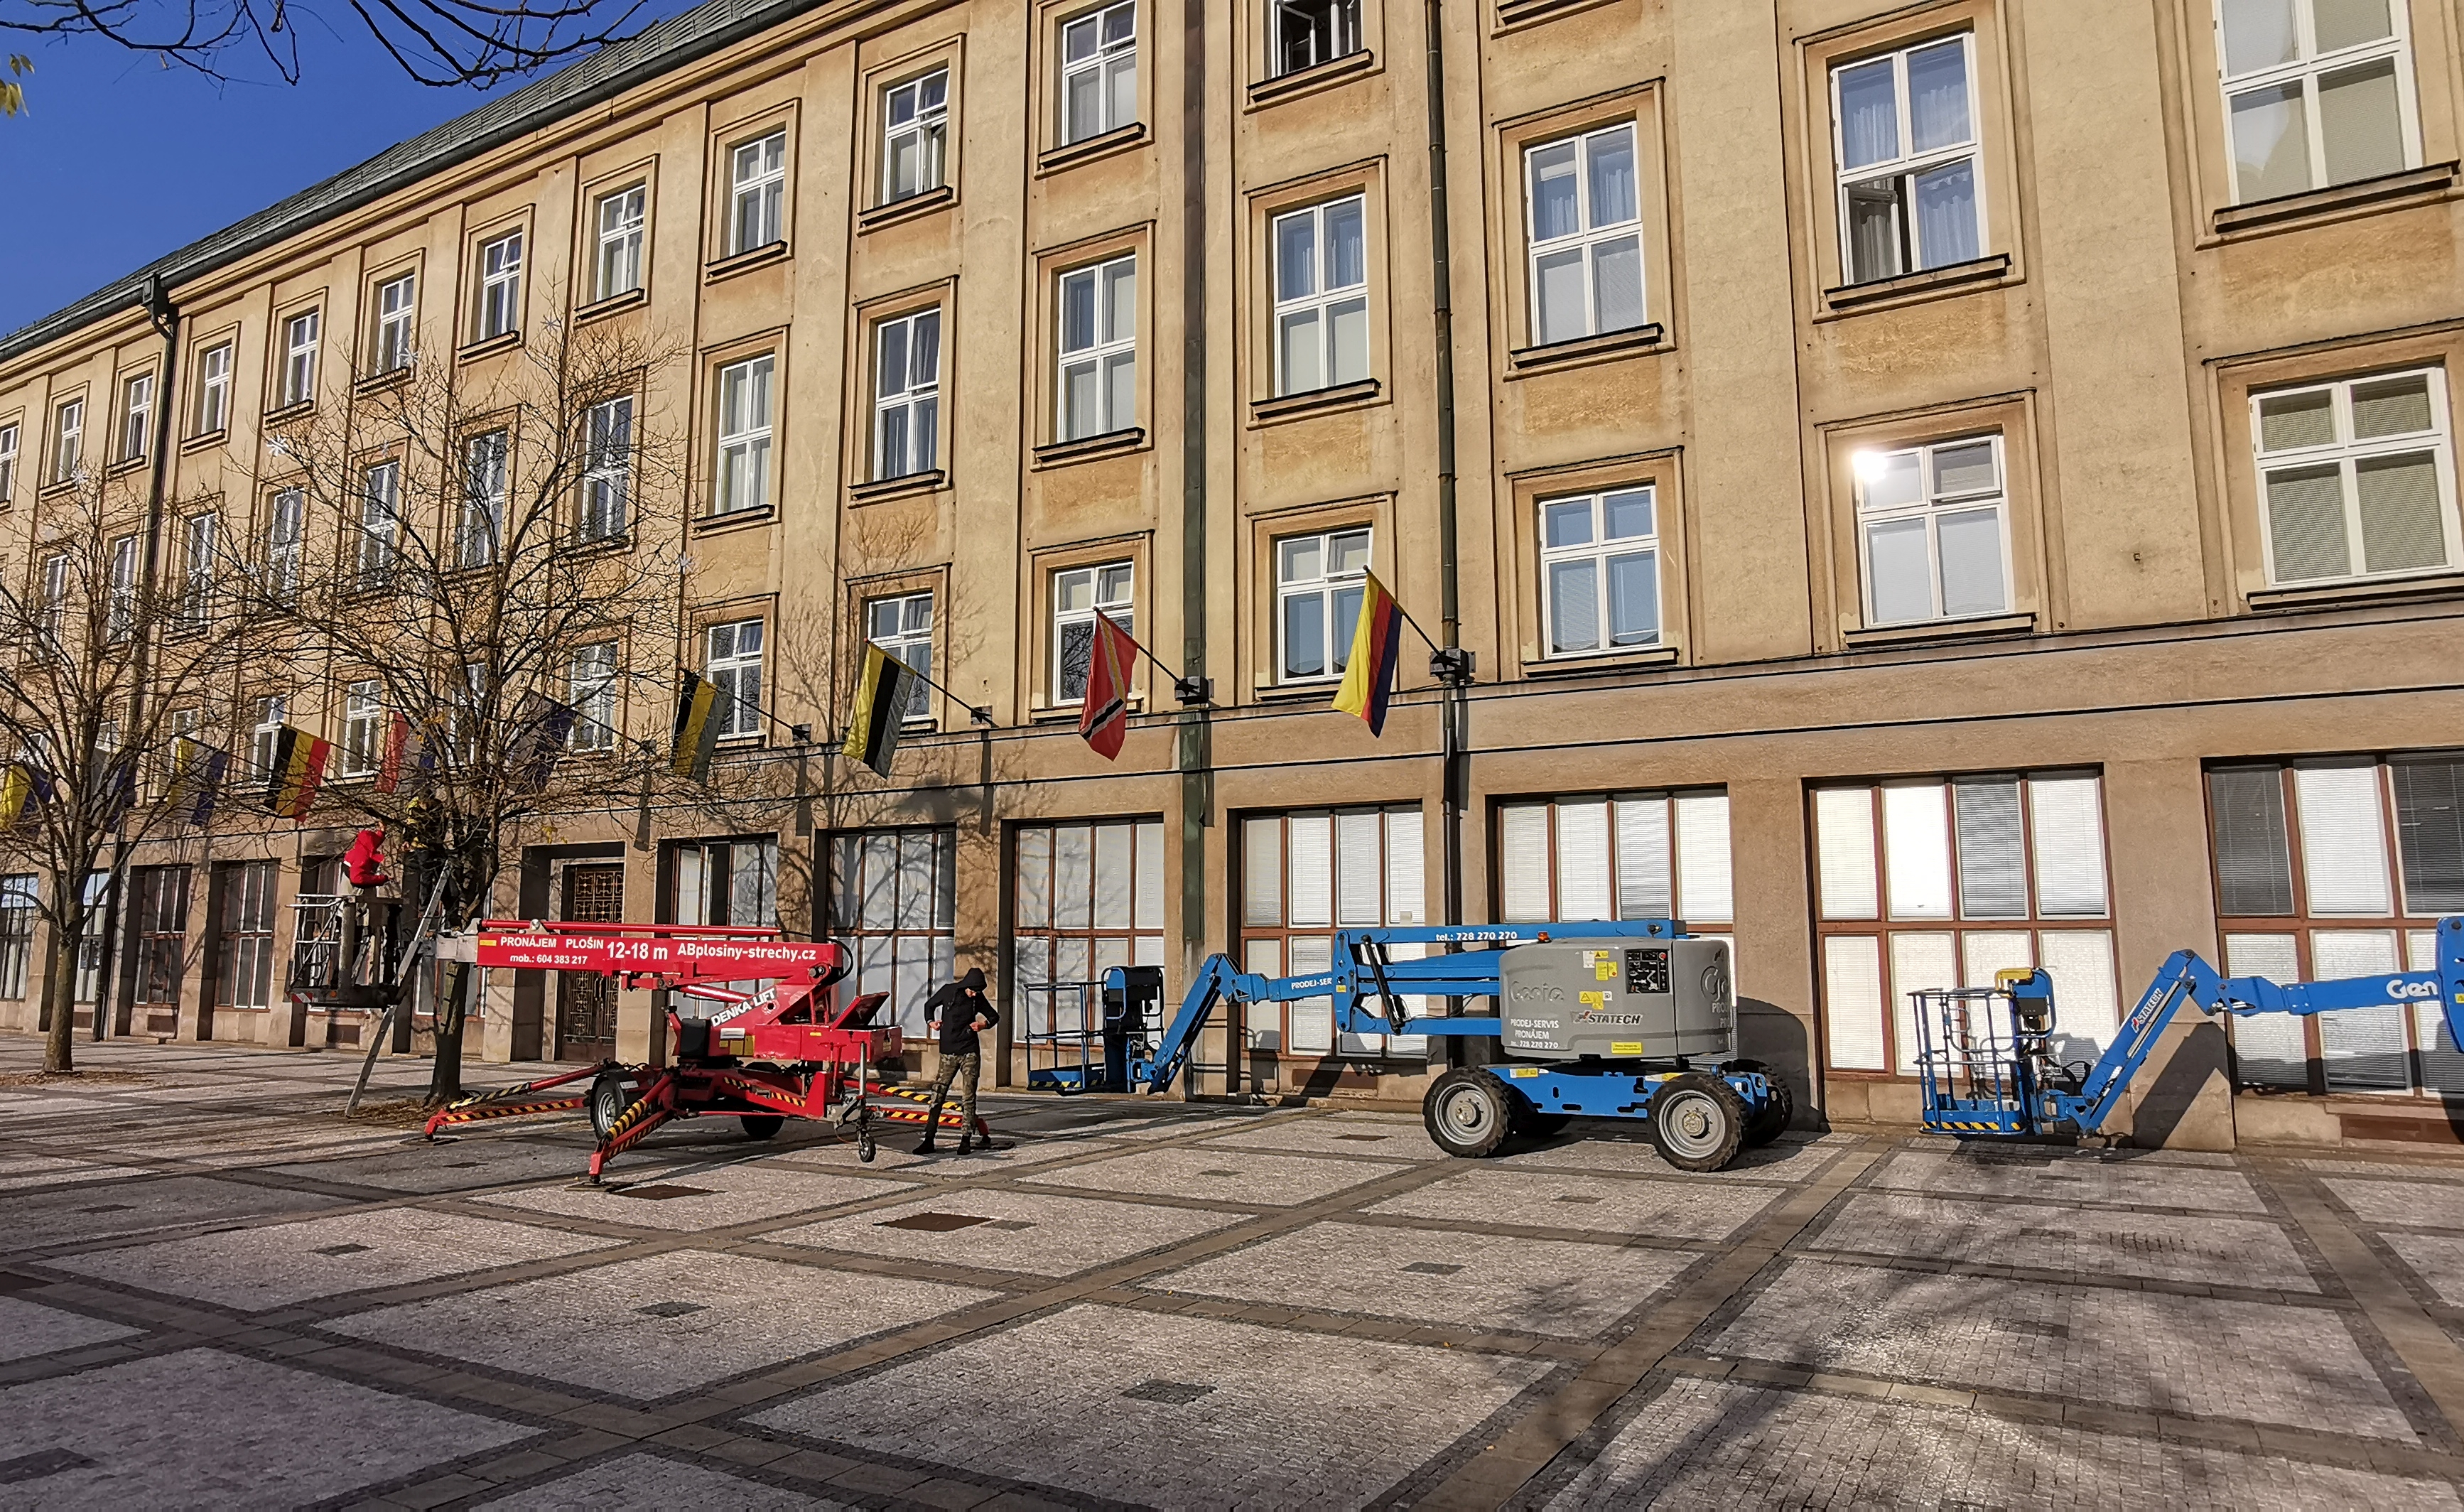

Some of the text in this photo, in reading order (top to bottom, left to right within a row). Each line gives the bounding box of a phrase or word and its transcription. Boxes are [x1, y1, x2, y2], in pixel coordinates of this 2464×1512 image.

[1436, 931, 1518, 941] tel.: 728 270 270
[500, 936, 556, 948] PRONÁJEM
[566, 936, 603, 949] PLOŠIN
[607, 941, 668, 960] 12-18 m
[677, 942, 816, 962] ABplosiny-strechy.cz
[510, 954, 588, 965] mob.: 604 383 217
[711, 988, 775, 1027] DENKA LIFT
[2137, 989, 2162, 1024] STATECH
[1511, 1018, 1560, 1029] PRODEJ-SERVIS
[1588, 1014, 1641, 1024] STATECH
[1515, 1028, 1550, 1040] PRONÁJEM
